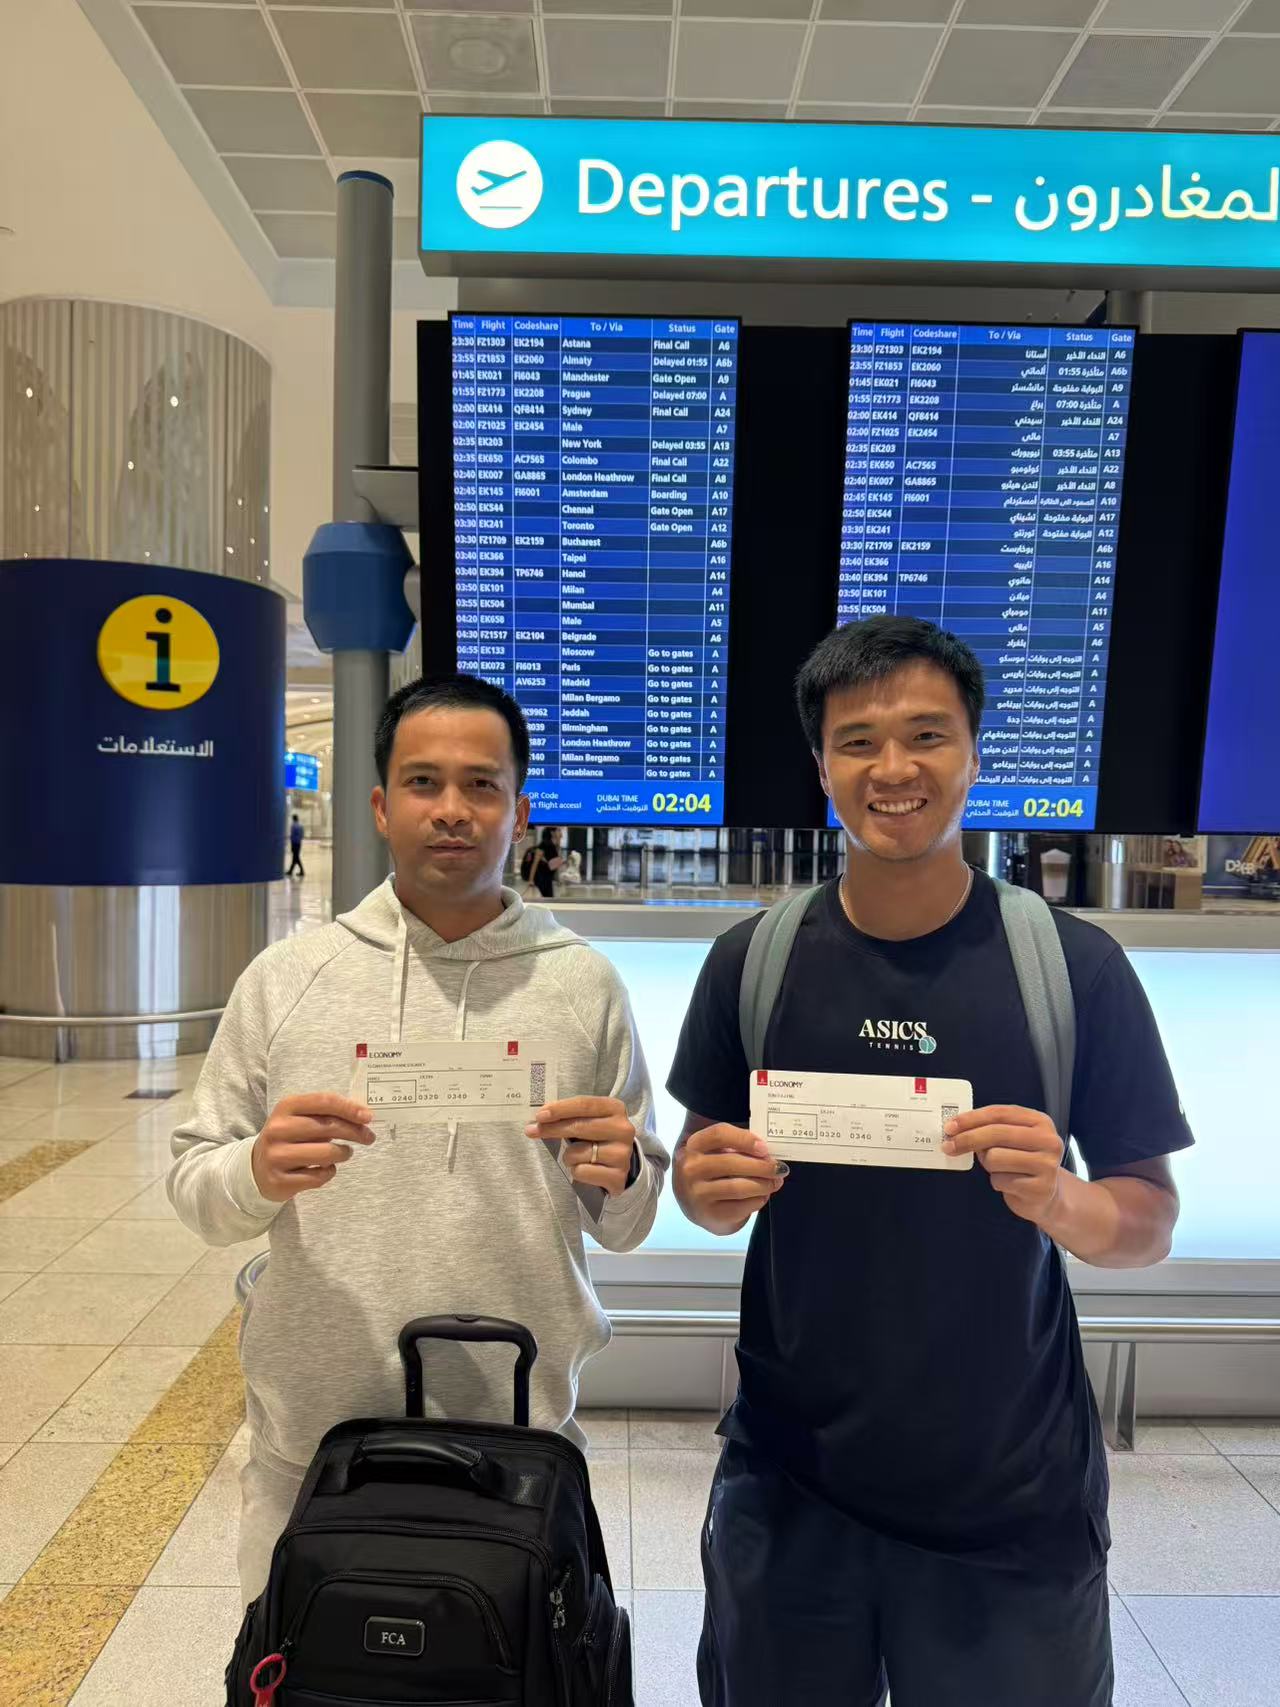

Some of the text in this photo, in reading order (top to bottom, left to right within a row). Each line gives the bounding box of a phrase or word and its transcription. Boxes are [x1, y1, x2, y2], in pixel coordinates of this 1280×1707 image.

[578, 158, 949, 232] Departures
[1014, 164, 1280, 232] لمغادرون
[453, 320, 474, 329] Time
[481, 320, 505, 332] Flight
[514, 321, 559, 330] Codeshare
[591, 322, 601, 331] To
[609, 322, 623, 332] Via
[668, 323, 696, 333] Status
[714, 324, 735, 334] Gate
[852, 328, 873, 337] Time
[881, 328, 904, 339] Flight
[913, 329, 957, 339] Codeshare
[988, 331, 1000, 339] To
[1007, 330, 1021, 340] Via
[1066, 332, 1093, 341] Status
[1111, 333, 1132, 342] Gate
[452, 337, 475, 347] 23:30
[562, 339, 591, 348] Astana
[654, 340, 673, 350] Final
[675, 340, 689, 350] Call
[718, 341, 730, 350] A6
[851, 345, 872, 353] 23:30
[1114, 351, 1126, 359] A6
[453, 354, 475, 364] 23:55
[562, 355, 592, 367] Almaty
[654, 357, 685, 367] Delayed
[687, 357, 707, 366] 01:55
[716, 358, 732, 367] A6b
[1058, 366, 1081, 376] 01:55
[1111, 367, 1127, 375] A6b
[453, 371, 475, 380] 01:45
[563, 372, 610, 382] Manchester
[653, 374, 672, 383] Gate
[674, 374, 696, 385] Open
[718, 375, 729, 384] A9
[453, 387, 475, 397] 01:55
[562, 388, 591, 400] Prague
[653, 390, 684, 401] Delayed
[686, 390, 707, 399] 07:00
[720, 392, 726, 400] A
[453, 404, 476, 414] 02:00
[562, 405, 592, 417] Sydney
[653, 407, 671, 416] Final
[673, 407, 688, 416] Call
[714, 408, 730, 417] A24
[1107, 416, 1123, 424] A24
[454, 420, 476, 430] 02:00
[562, 422, 583, 431] Male
[716, 424, 728, 434] A7
[454, 437, 476, 446] 02:35
[562, 439, 581, 448] New
[583, 439, 602, 448] York
[652, 440, 683, 451] Delayed
[685, 440, 706, 449] 03:55
[713, 441, 729, 450] A13
[562, 455, 729, 467] Colombo Final Call A22
[562, 472, 726, 483] London Heathrow Final Call A8
[562, 488, 728, 501] Amsterdam Boarding A10
[562, 505, 727, 517] Chennai Gate Open A17
[562, 521, 727, 533] Toronto Gate Open A12
[562, 537, 601, 546] Bucharest
[562, 553, 726, 564] Taipei A16
[562, 570, 725, 580] Hanoi A14
[562, 585, 584, 594] Milan
[562, 601, 724, 611] Mumbai A11
[562, 617, 582, 625] Male
[562, 632, 596, 642] Belgrade
[562, 648, 595, 656] Moscow
[562, 663, 580, 672] Paris
[562, 678, 590, 687] Madrid
[562, 694, 620, 703] Milan Bergamo
[561, 709, 589, 718] Jeddah
[562, 724, 608, 734] Birmingham
[97, 735, 214, 757] الاستعلامات
[562, 768, 603, 777] Casablanca
[528, 792, 559, 800] QR Code
[538, 801, 558, 809] flight
[652, 793, 712, 813] 02:04
[1023, 798, 1084, 817] 02:04
[858, 1019, 927, 1041] ASICS
[869, 1042, 914, 1051] TENNIS
[369, 1051, 402, 1059] ECONOMY
[769, 1080, 803, 1088] ECONOMY
[381, 1631, 406, 1646] FCA
